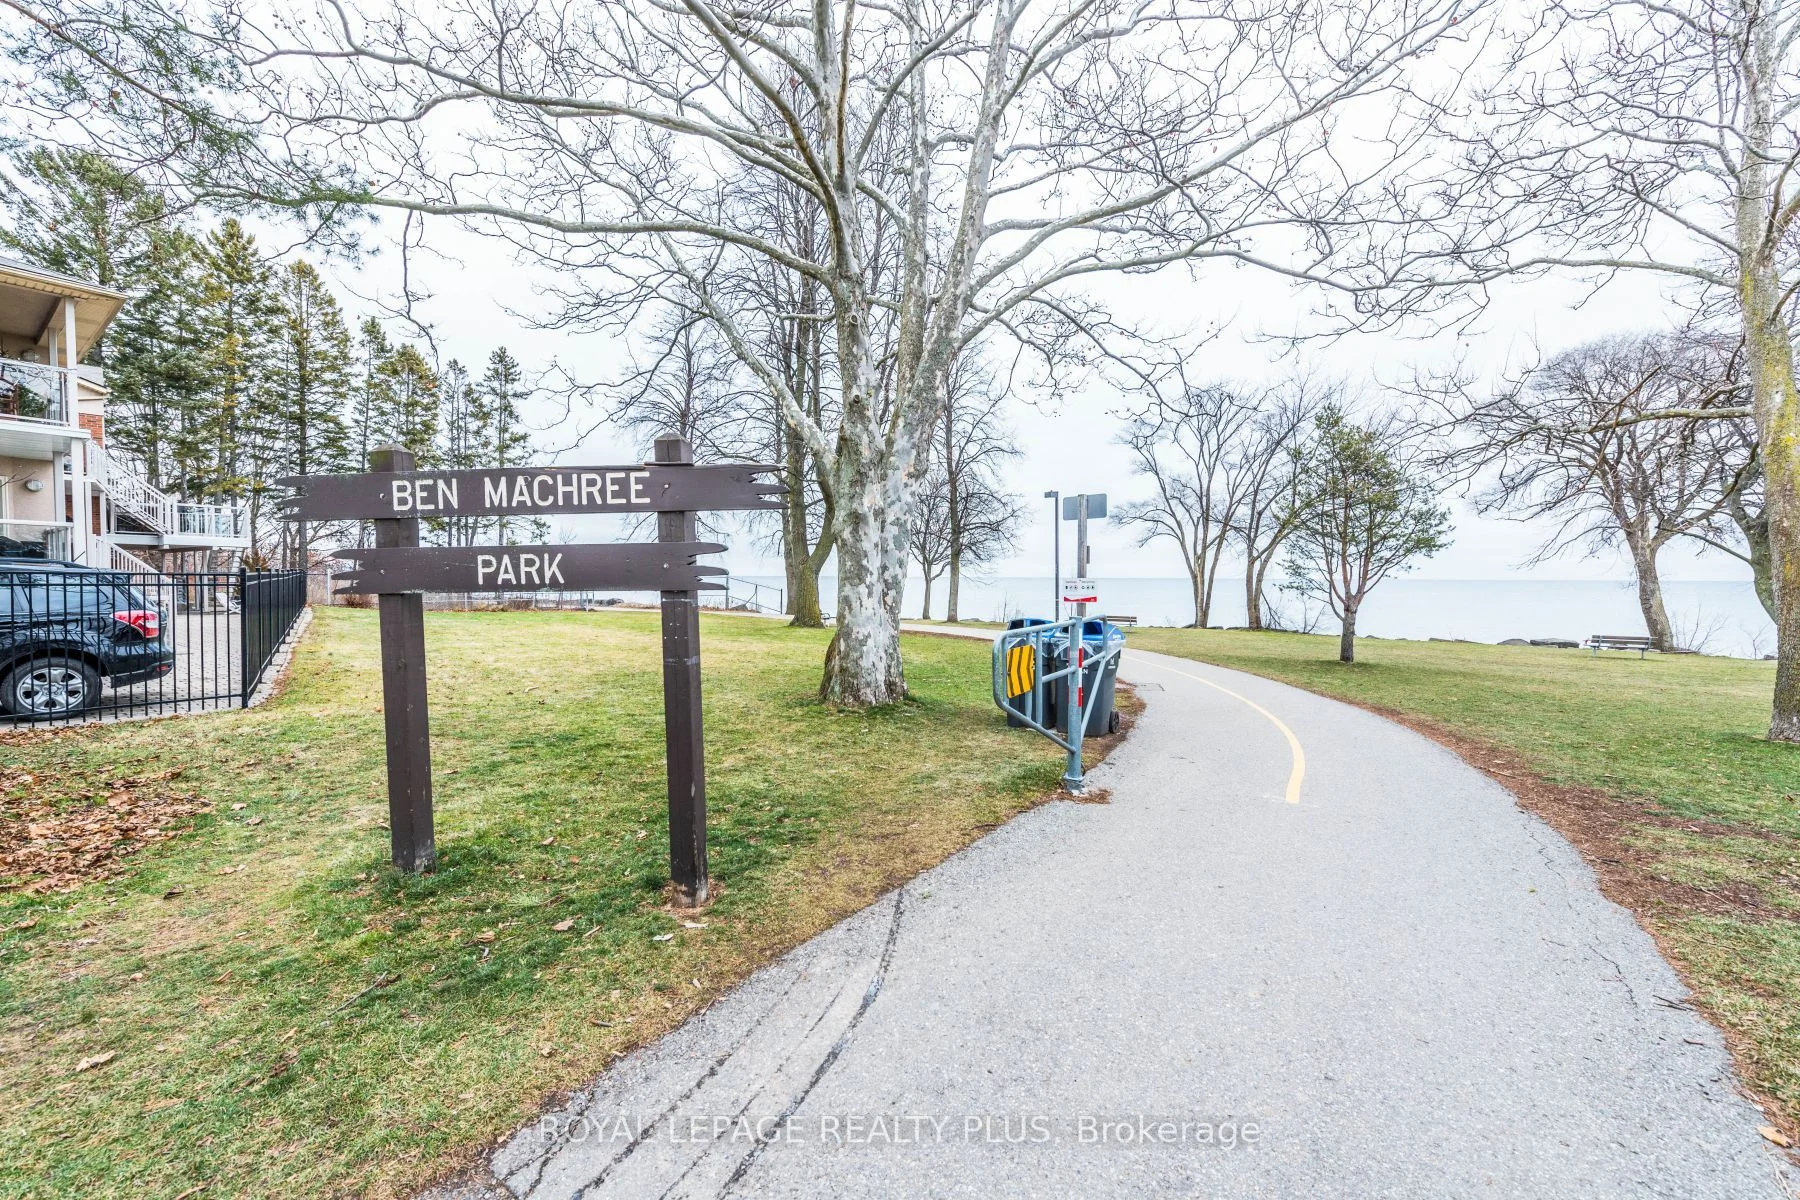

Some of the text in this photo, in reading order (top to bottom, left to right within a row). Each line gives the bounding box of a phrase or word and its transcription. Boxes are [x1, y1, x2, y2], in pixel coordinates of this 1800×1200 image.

[392, 471, 651, 511] BEN MACHREE
[477, 552, 565, 585] PARK
